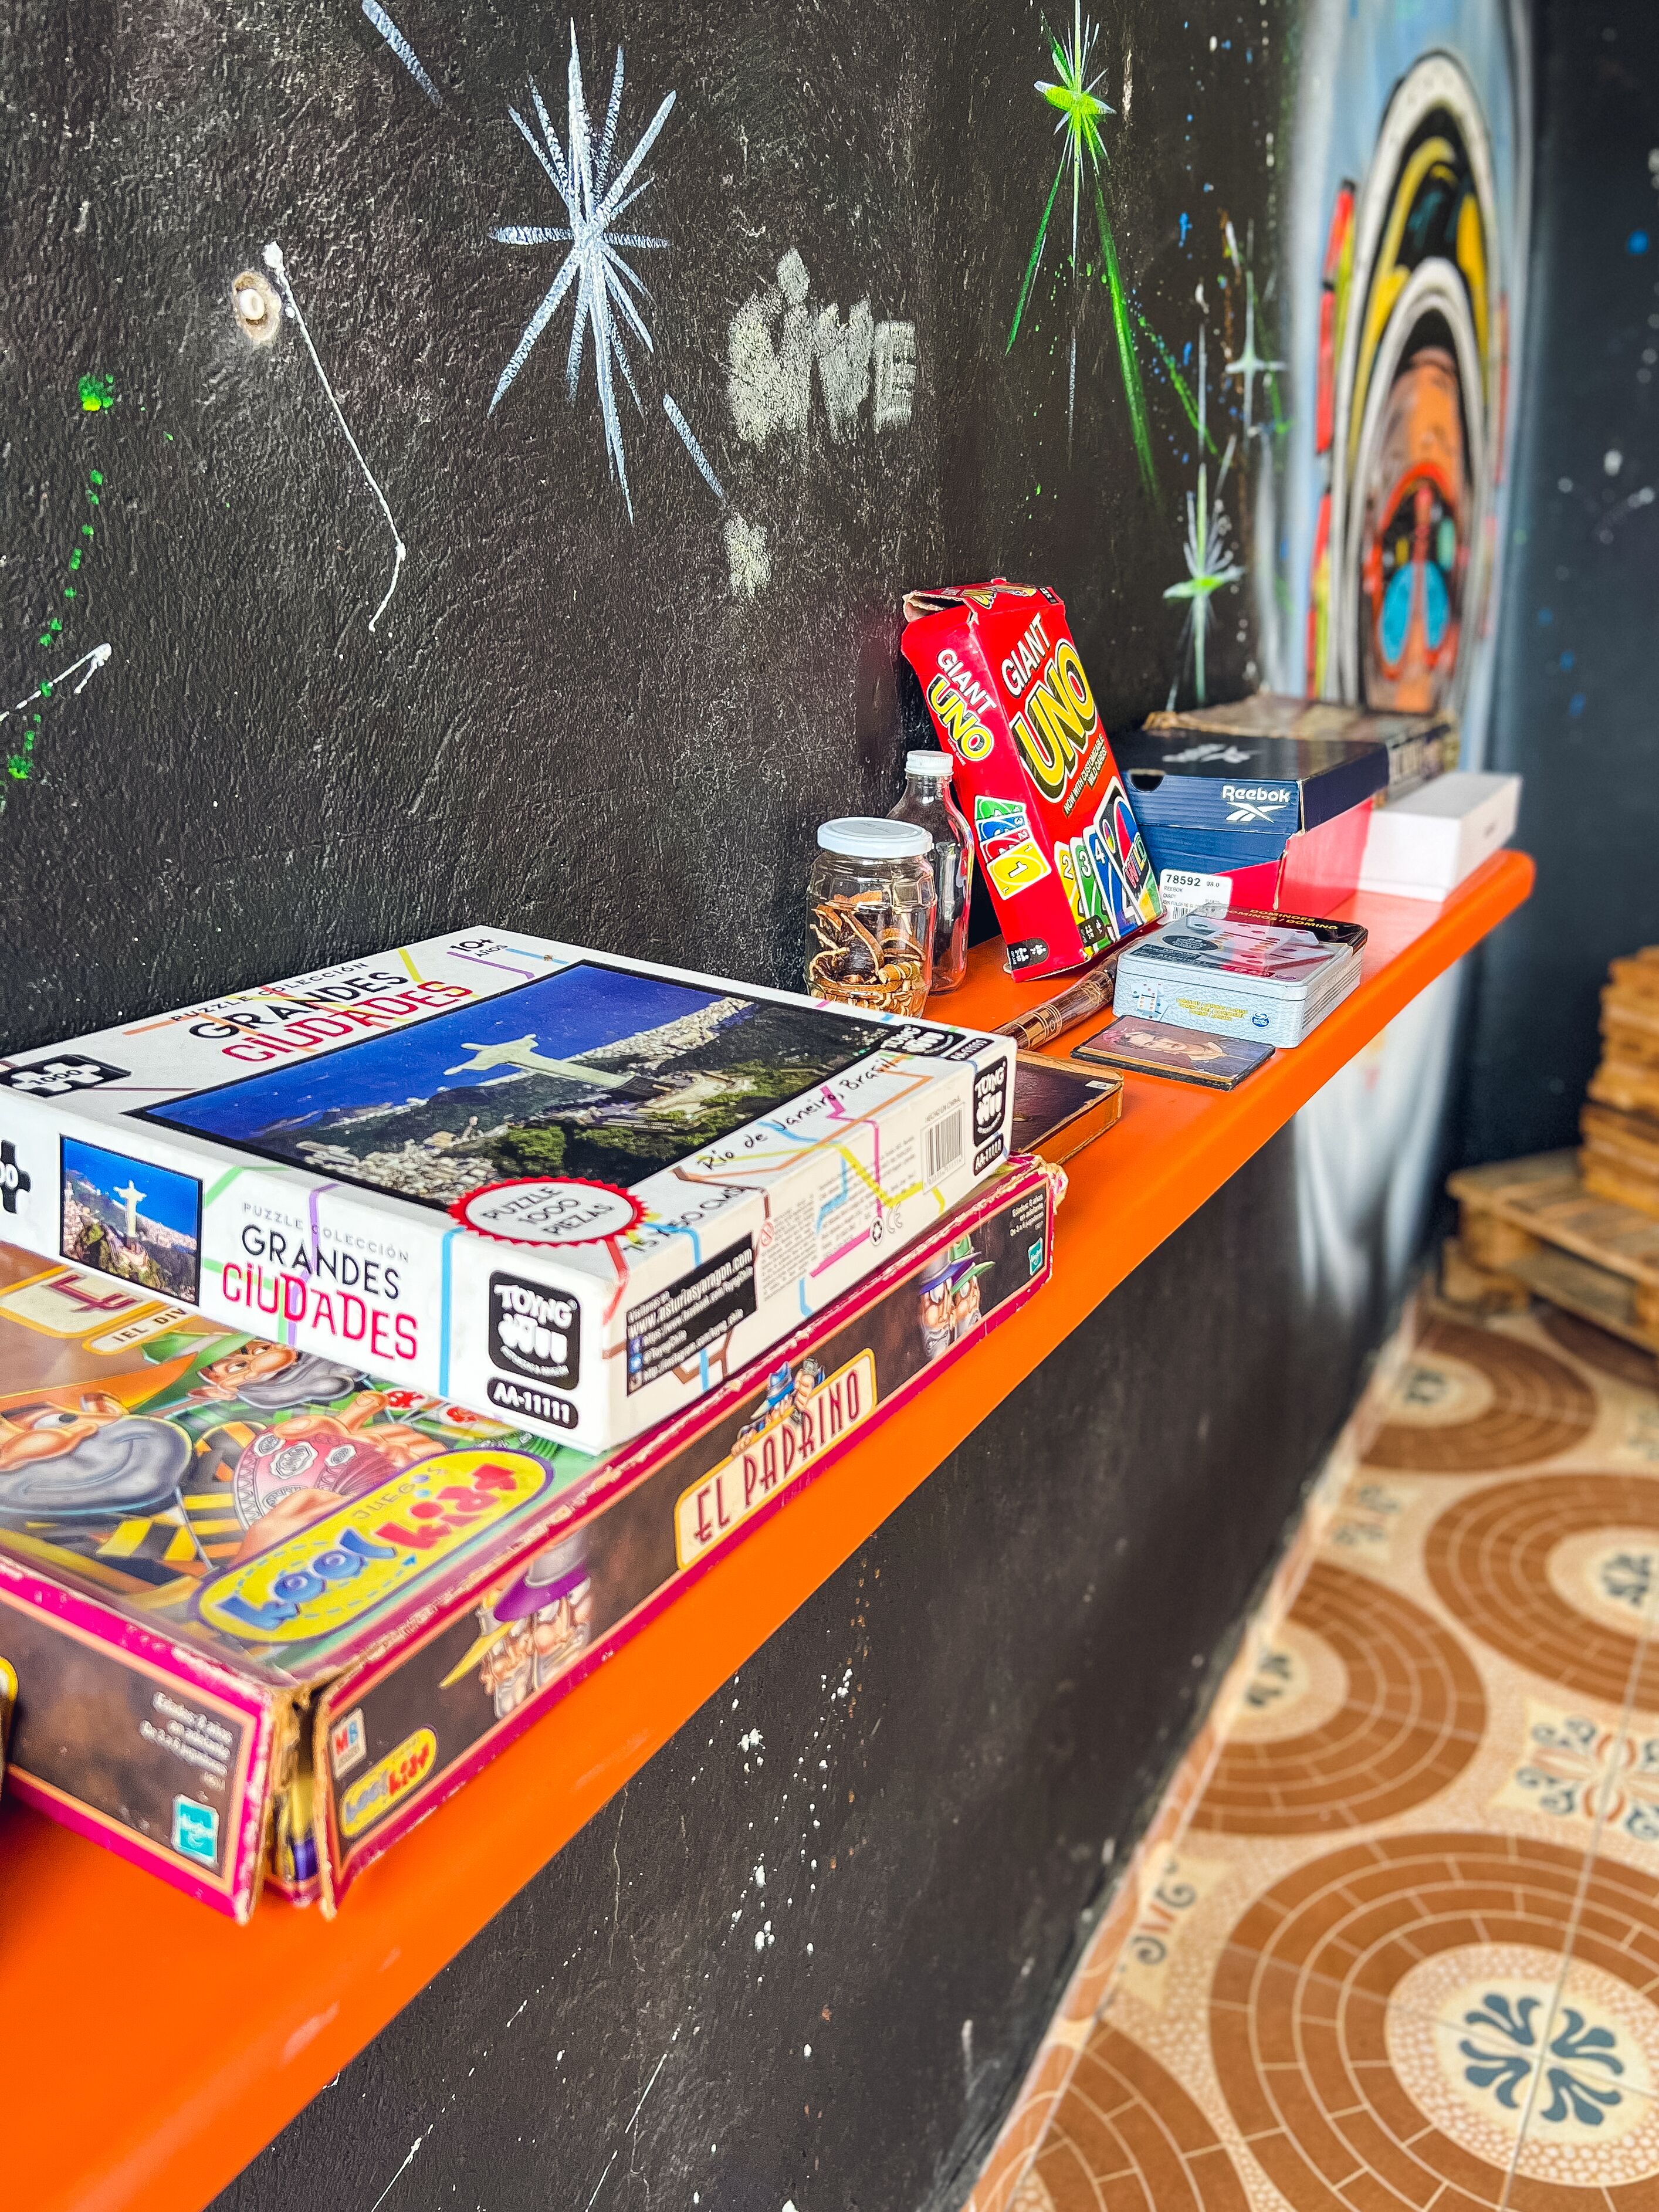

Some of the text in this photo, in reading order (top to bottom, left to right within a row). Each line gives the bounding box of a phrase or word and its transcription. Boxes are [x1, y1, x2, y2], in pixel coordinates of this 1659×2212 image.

[1001, 612, 1051, 697] GIANT
[937, 649, 997, 714] GIANT
[927, 673, 994, 761] UNO
[1009, 638, 1097, 803] UNO
[1064, 733, 1104, 814] NOW WITH CUSTOMIZABLE
[1087, 766, 1098, 787] WILD
[1223, 785, 1291, 802] Reebok
[1061, 854, 1074, 879] 2
[1079, 851, 1091, 877] 3
[1095, 838, 1106, 864] 4
[1124, 832, 1147, 889] WILD
[1008, 861, 1028, 879] 1
[1166, 874, 1201, 886] 78592
[1227, 910, 1278, 921] OMINOS
[1286, 919, 1338, 930] DOMINO
[1250, 909, 1315, 922] DOMINOES
[449, 938, 495, 953] 10+
[170, 962, 370, 1022] PUZZLE COLECCIÓN
[189, 971, 409, 1038] GRANDES
[881, 1026, 920, 1049] TOYNG
[29, 1069, 82, 1085] 1000
[975, 1066, 1004, 1098] TOYNG
[697, 1058, 898, 1170] Rio de Janeiro, Brasil
[976, 1139, 1001, 1172] AA-11111
[481, 1187, 563, 1220] PUZZLE
[518, 1198, 581, 1224] 1000
[542, 1204, 615, 1235] PIEZAS
[243, 1202, 409, 1262] PUZZLE COLECCIÓN
[242, 1224, 400, 1299] GRANDES
[493, 1283, 572, 1329] TOYNG
[628, 1248, 753, 1339] www.asturiasyaragon.com
[493, 1381, 570, 1424] AA-11111
[695, 1369, 860, 1544] EL PADRINO
